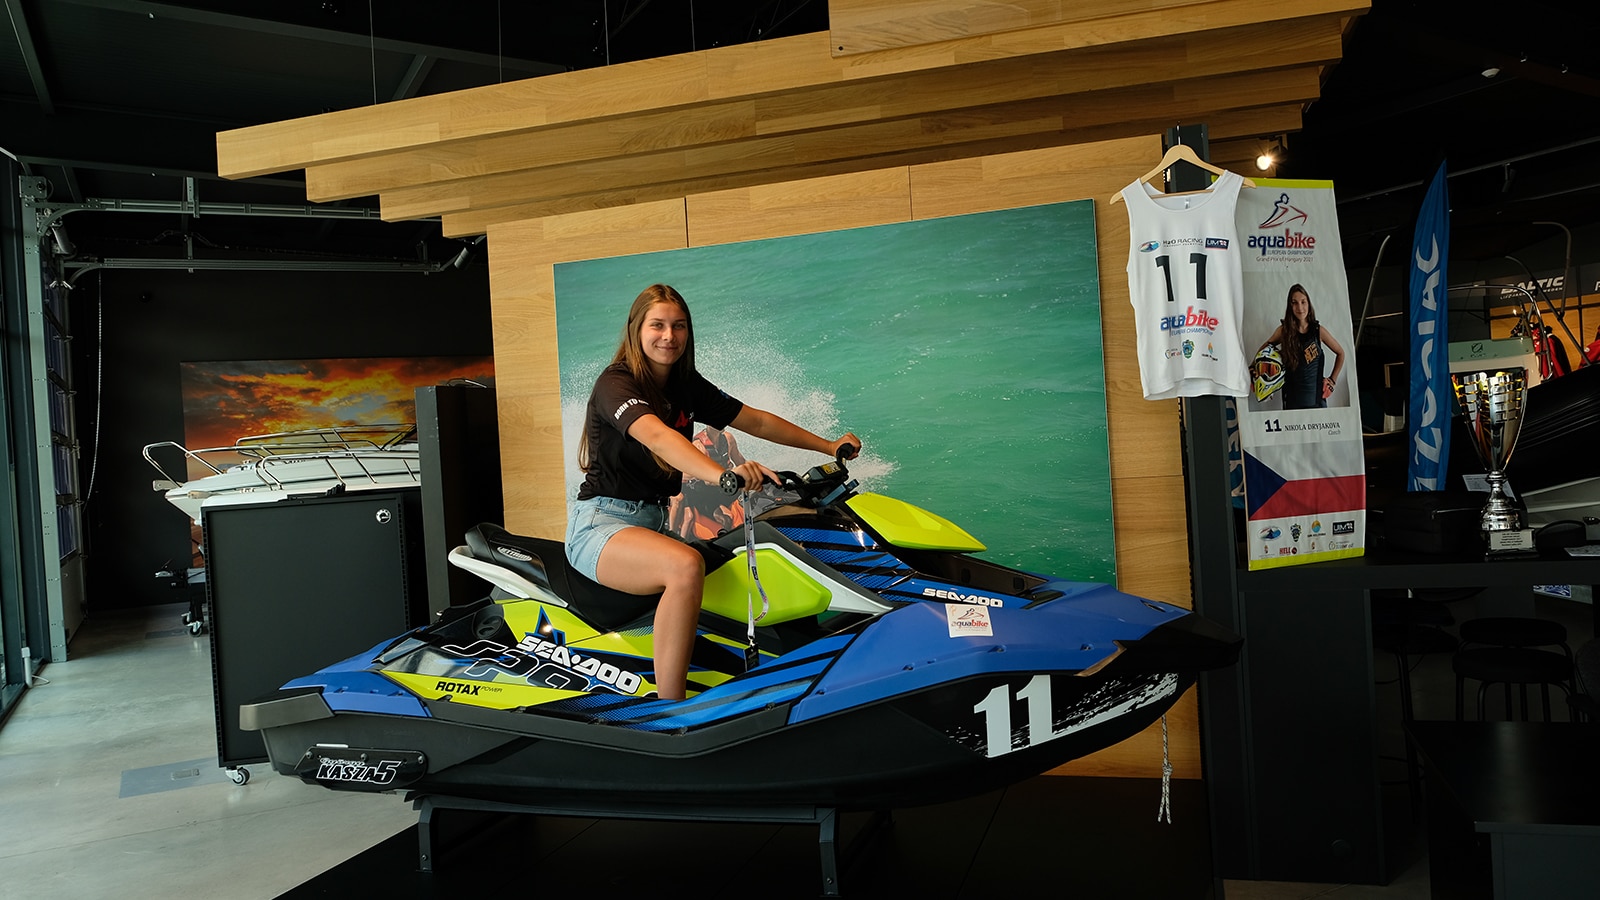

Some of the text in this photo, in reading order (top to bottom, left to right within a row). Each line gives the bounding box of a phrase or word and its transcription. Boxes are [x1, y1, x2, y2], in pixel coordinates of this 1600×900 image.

[1247, 228, 1316, 256] aquabike
[614, 402, 629, 420] BORN
[1264, 418, 1282, 432] 11
[1285, 424, 1306, 432] NIKOLA
[435, 681, 481, 696] ROTAX
[973, 674, 1053, 758] 11
